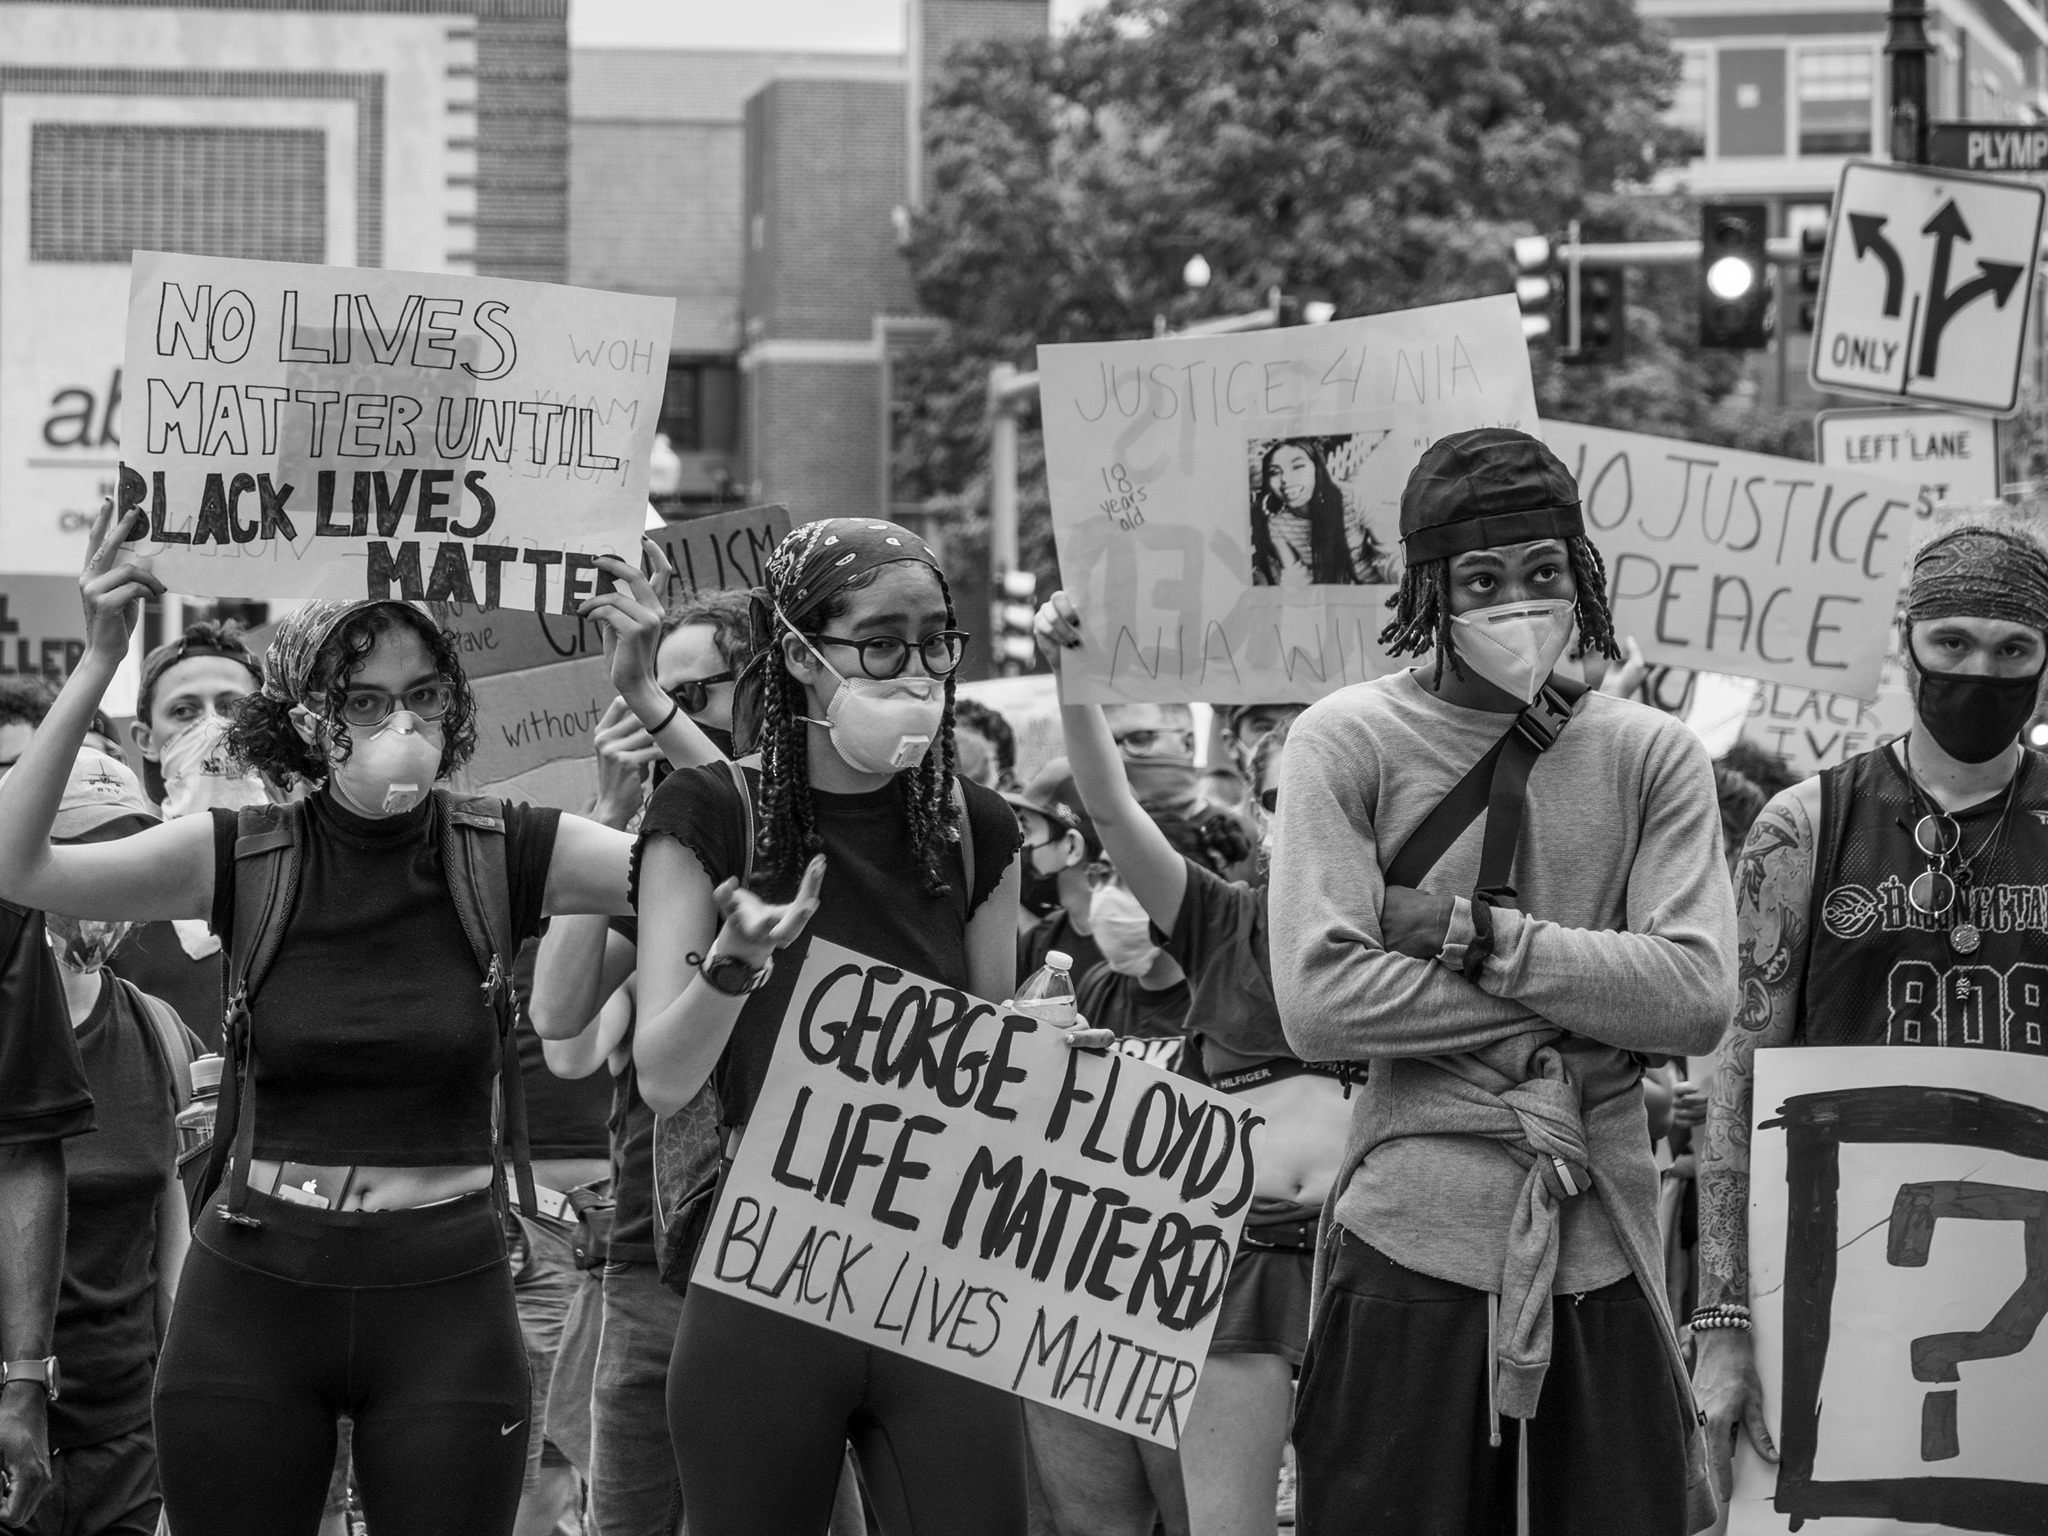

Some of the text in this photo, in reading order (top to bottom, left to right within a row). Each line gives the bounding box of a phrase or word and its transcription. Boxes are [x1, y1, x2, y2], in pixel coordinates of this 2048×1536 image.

[157, 282, 517, 380] NO LIVES
[1831, 332, 1900, 374] ONLY
[1075, 335, 1484, 426] JUSTICE 4 NIA
[146, 379, 620, 469] MATTER UNTIL
[1846, 431, 1971, 463] LEFT LANE
[118, 461, 496, 544] BLACK LIVES
[1100, 487, 1148, 518] years
[1101, 463, 1133, 494] 18
[1118, 510, 1145, 532] old
[1637, 455, 1910, 579] JUSTICE
[1607, 553, 1863, 670] PEACE
[1108, 619, 1241, 688] NIA
[502, 699, 601, 748] without
[1767, 725, 1898, 761] IVE
[799, 964, 1266, 1219] GEORGE FLOYD'S
[1219, 1068, 1272, 1088] HILFIGER
[771, 1085, 948, 1232] LIFE
[713, 1196, 1198, 1448] BLACK LIVES MATTER
